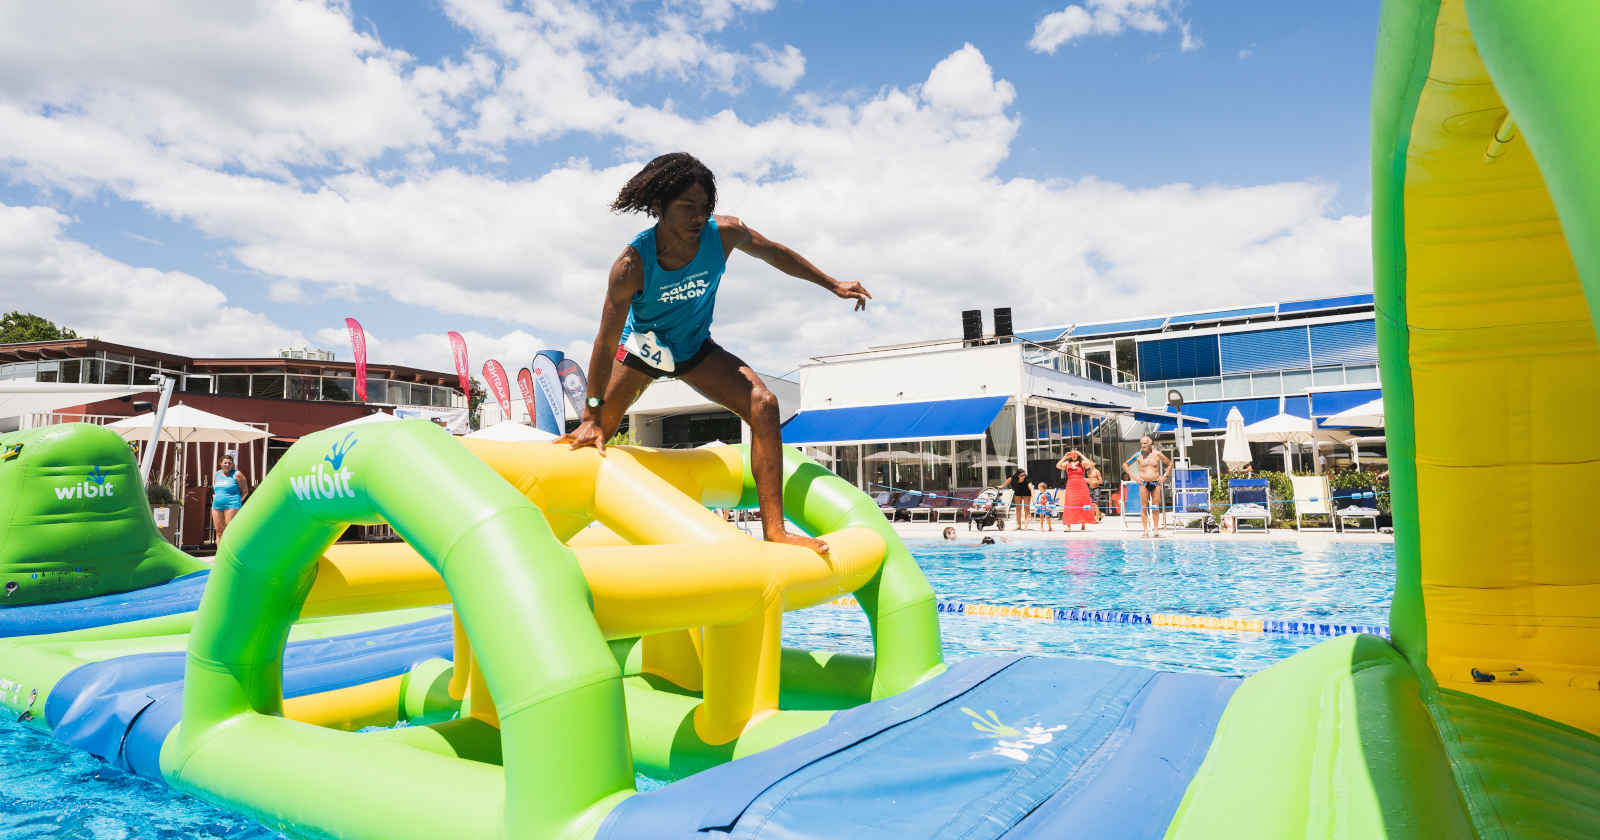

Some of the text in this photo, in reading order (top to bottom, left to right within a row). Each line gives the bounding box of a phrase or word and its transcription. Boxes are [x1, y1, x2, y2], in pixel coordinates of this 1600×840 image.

[640, 343, 662, 365] 54
[54, 481, 115, 500] wibit
[289, 463, 356, 501] wibit
